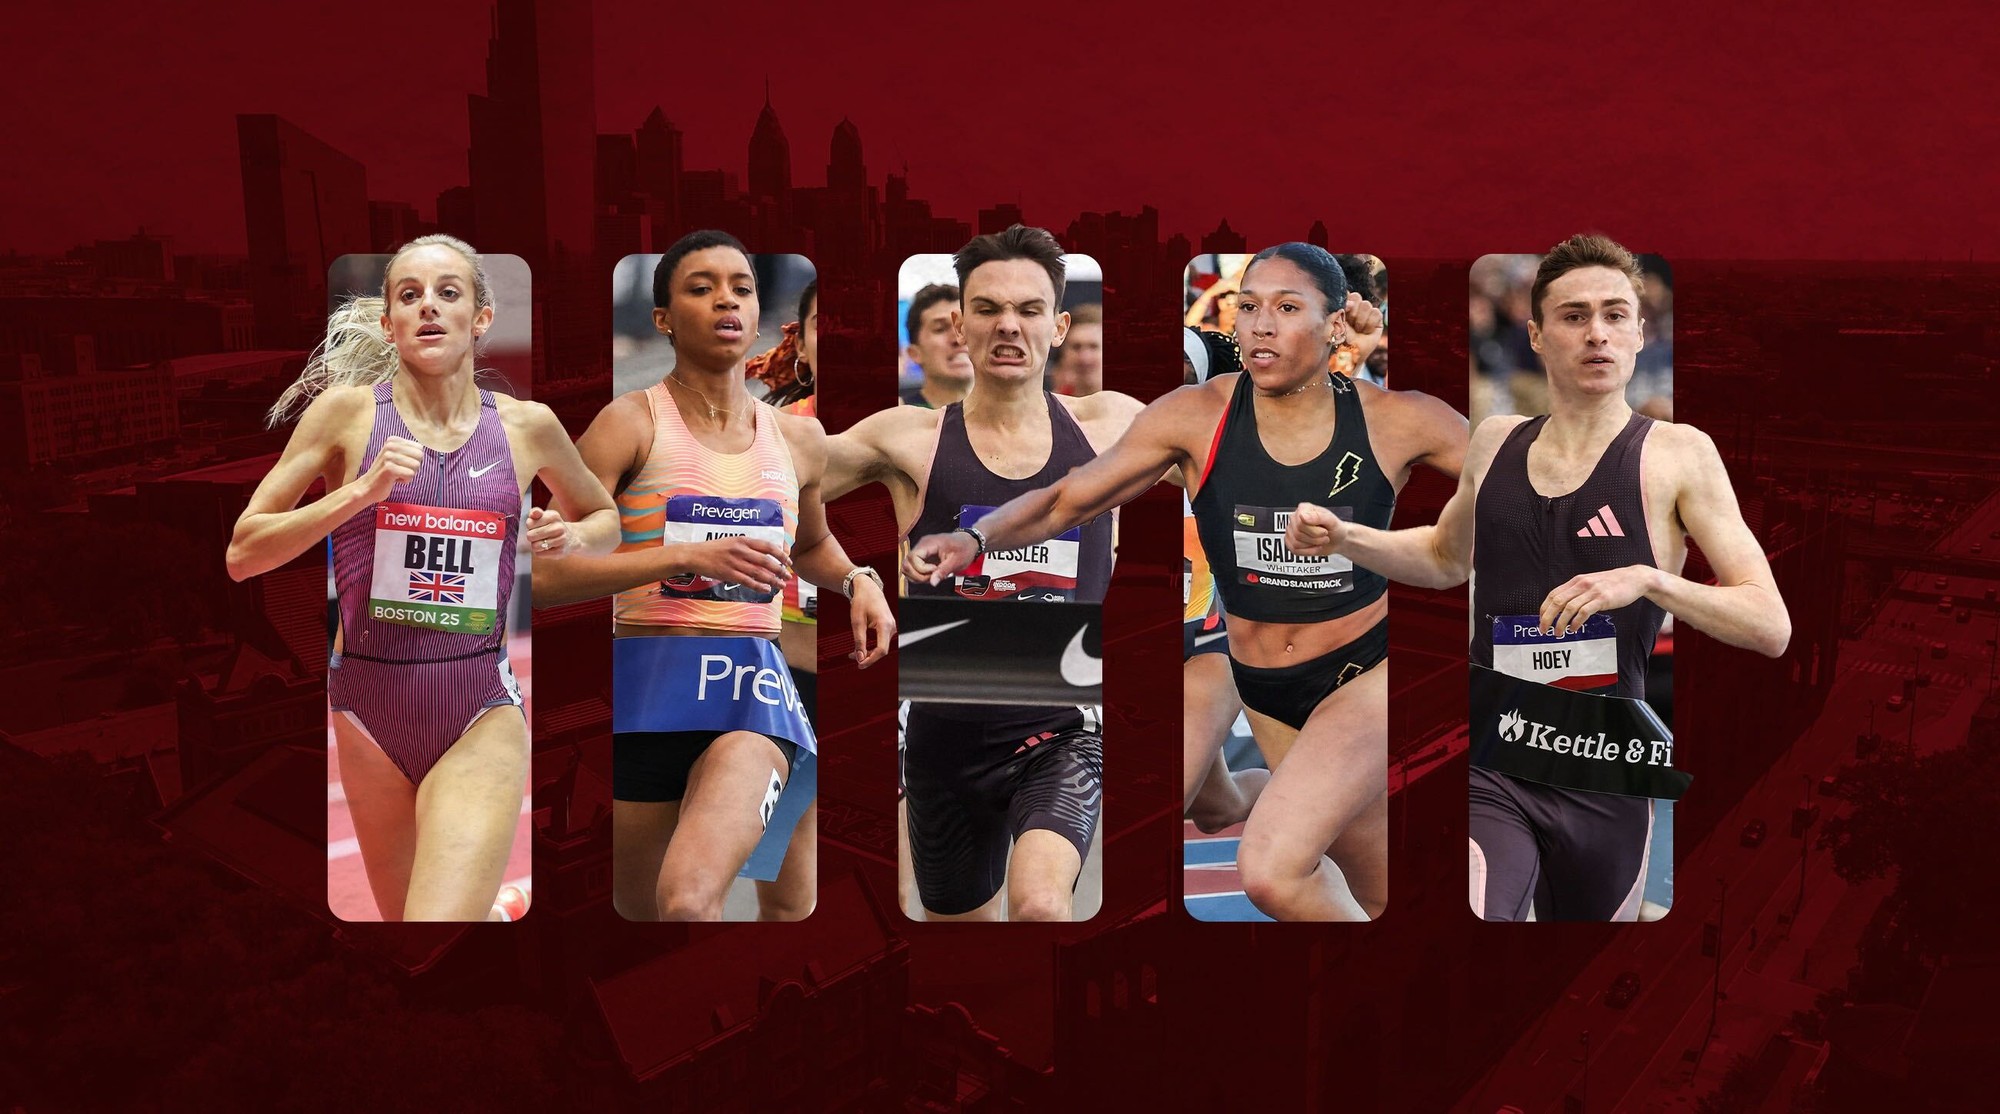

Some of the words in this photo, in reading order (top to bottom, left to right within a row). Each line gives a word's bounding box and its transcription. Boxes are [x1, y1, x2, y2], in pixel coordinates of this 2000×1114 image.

[385, 512, 421, 527] new
[425, 513, 497, 535] balance
[691, 503, 760, 523] Prevagen
[404, 534, 475, 574] BELL
[1267, 563, 1321, 574] WHITTAKER
[374, 606, 437, 624] BOSTON
[440, 612, 460, 626] 25
[1532, 649, 1571, 670] HOEY
[1525, 721, 1620, 762] Kettle
[1625, 738, 1645, 764] &
[1647, 740, 1673, 767] Fi
